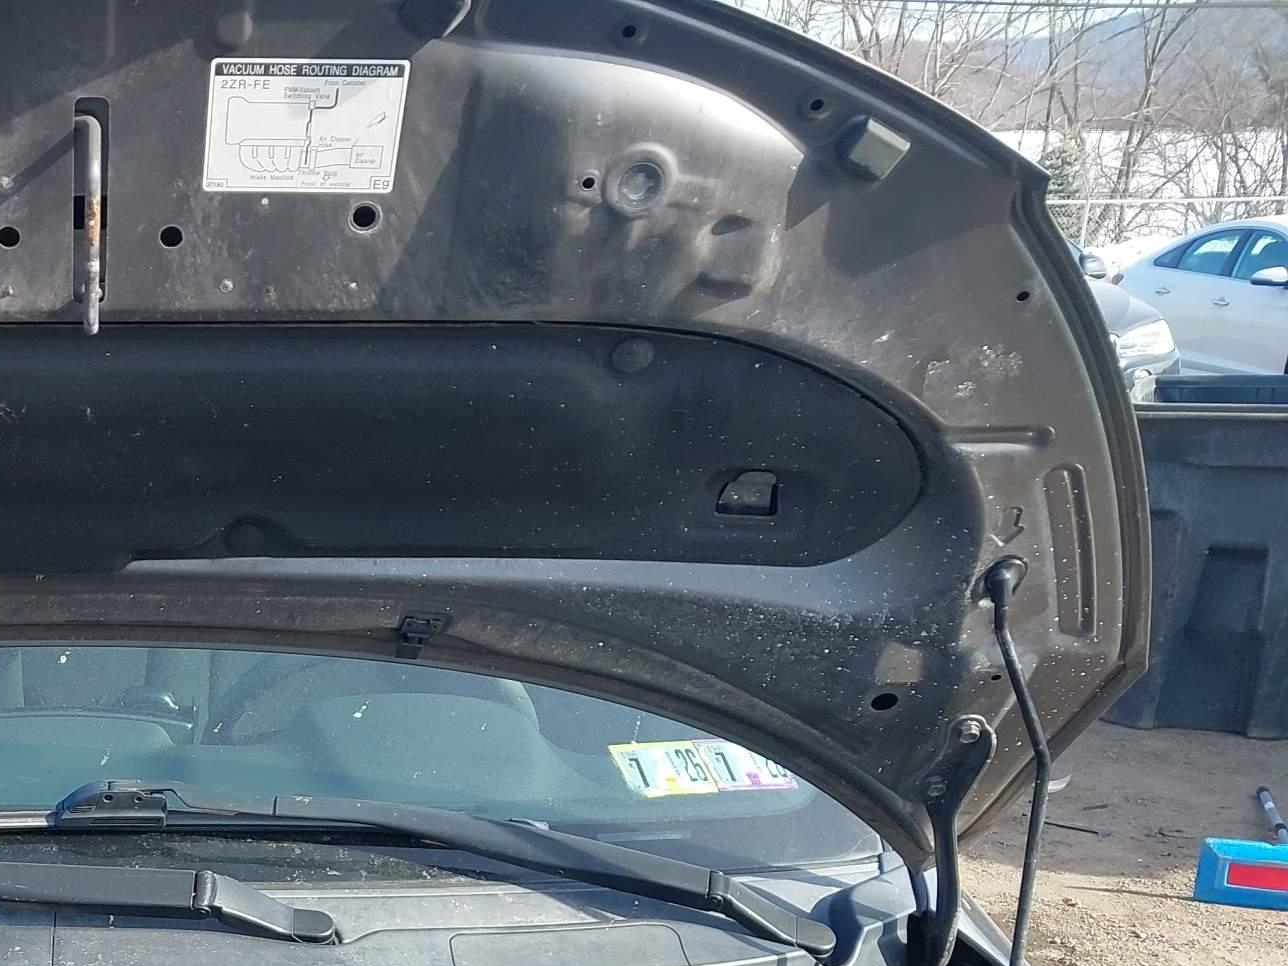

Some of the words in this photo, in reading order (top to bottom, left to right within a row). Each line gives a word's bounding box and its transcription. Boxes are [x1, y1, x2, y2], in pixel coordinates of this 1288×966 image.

[222, 64, 265, 75] VACUUM
[269, 64, 298, 75] HOSE
[302, 64, 348, 76] ROUTING
[352, 66, 399, 76] DIAGRAM
[220, 79, 271, 89] 2ZR-FE
[373, 179, 390, 190] E9
[674, 749, 708, 782] 26
